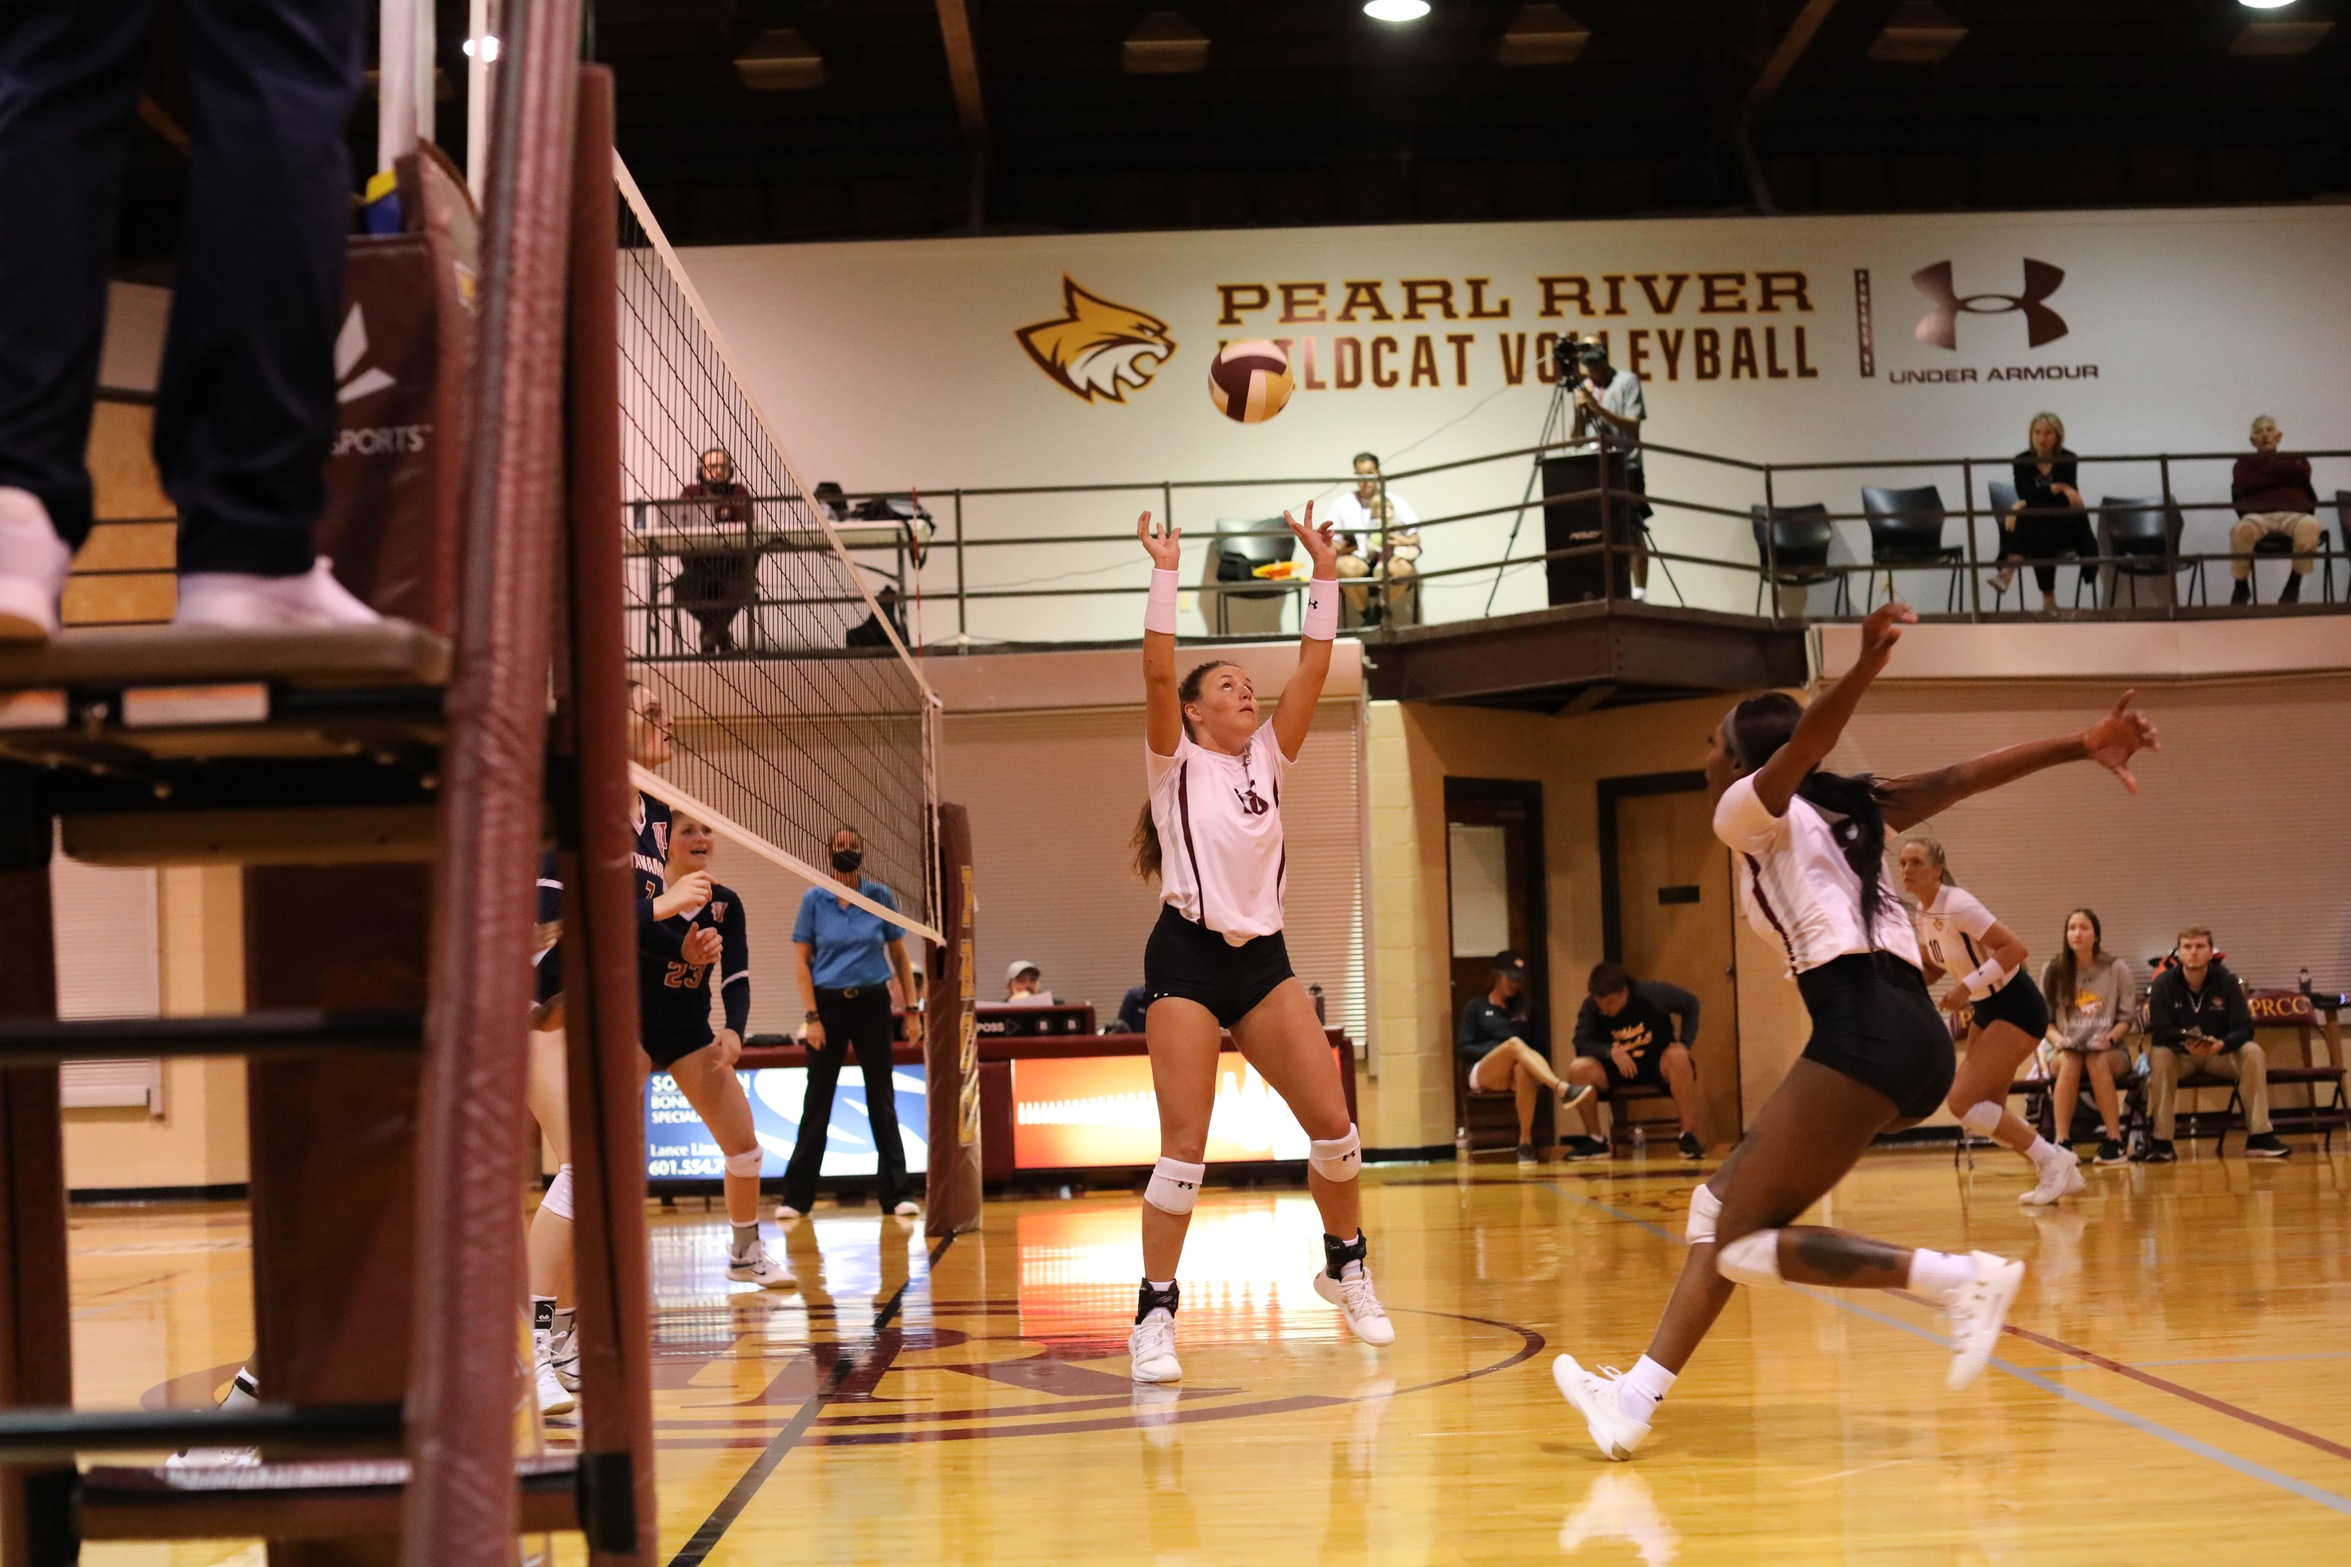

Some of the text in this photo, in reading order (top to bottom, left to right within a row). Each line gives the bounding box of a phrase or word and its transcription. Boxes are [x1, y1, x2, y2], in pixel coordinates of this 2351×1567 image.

[1216, 269, 1815, 326] PEARL RIVER
[1218, 324, 1819, 391] LDCAT VOEYBALL
[1889, 363, 2099, 385] UNDER ARMOUR
[1929, 939, 1945, 963] 10
[663, 960, 706, 989] 23
[2250, 996, 2309, 1016] PRCC
[648, 1158, 725, 1176] 601.554.7
